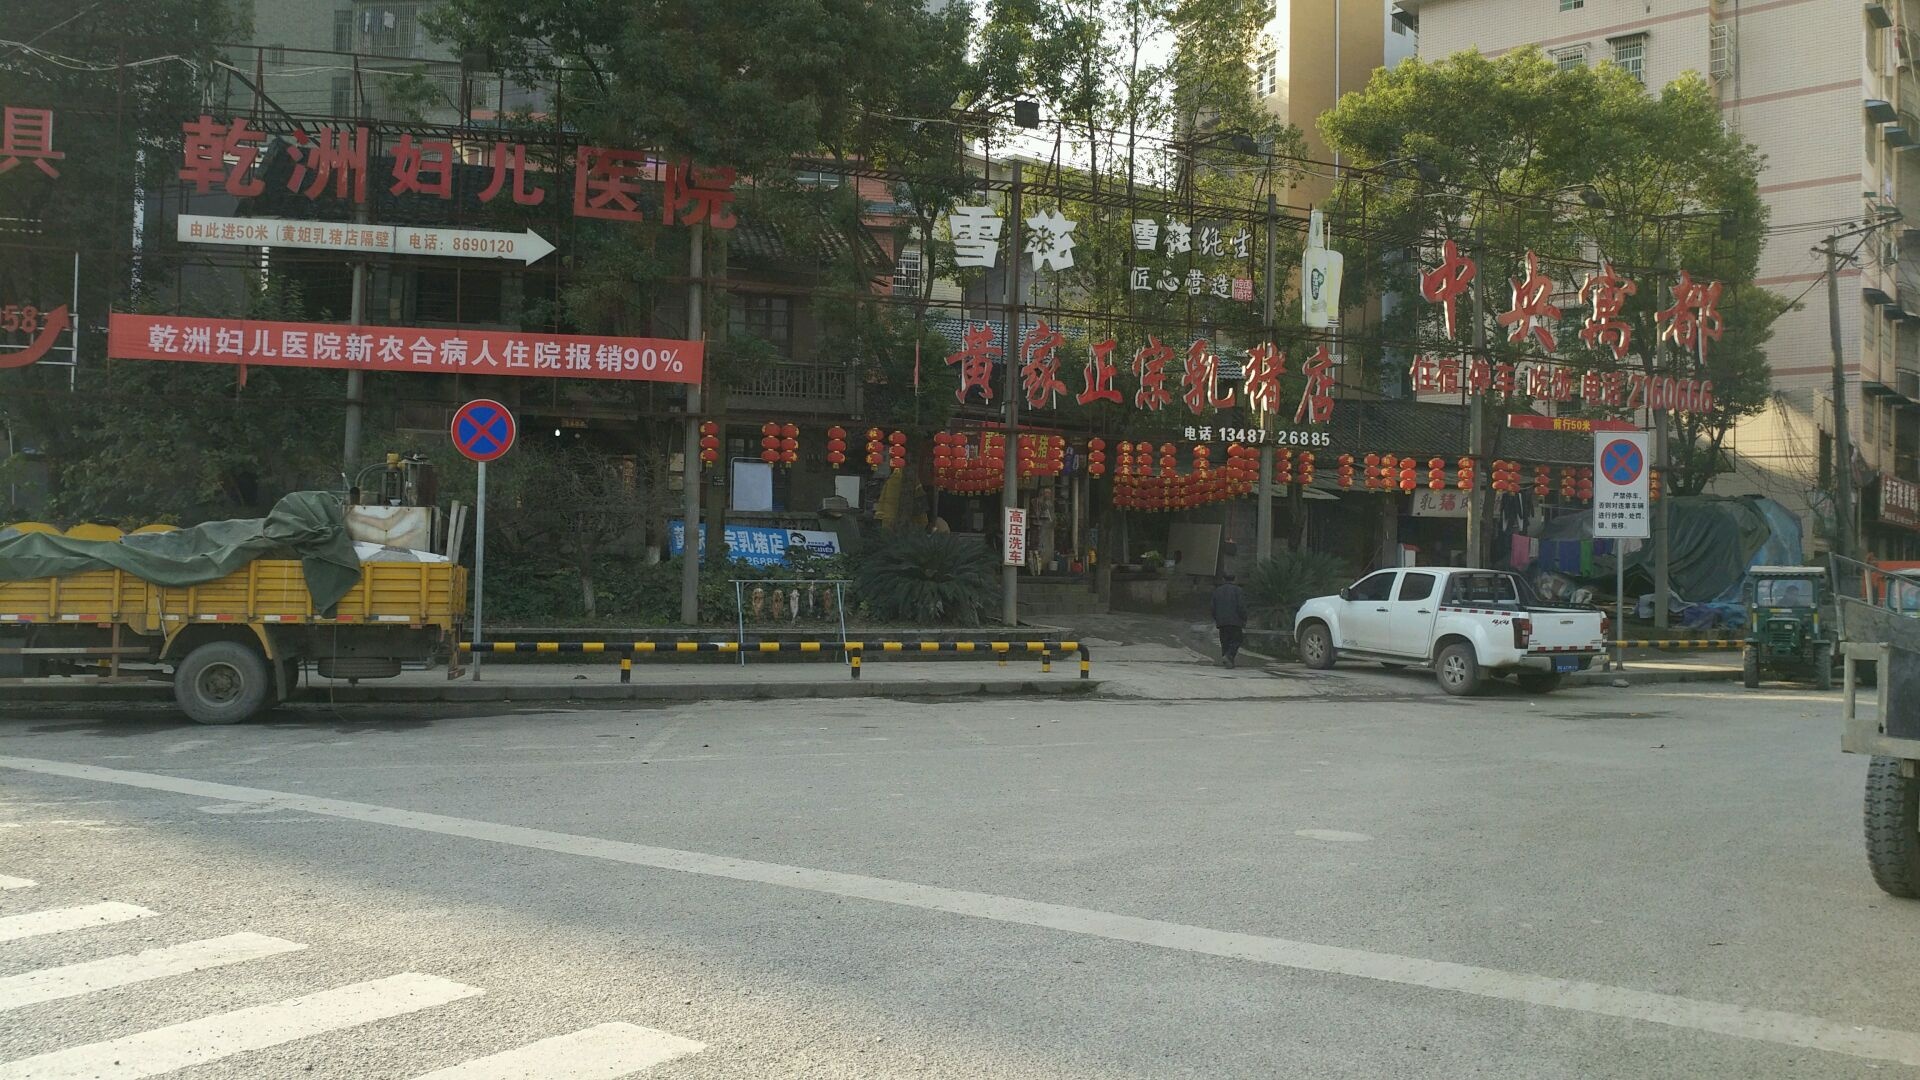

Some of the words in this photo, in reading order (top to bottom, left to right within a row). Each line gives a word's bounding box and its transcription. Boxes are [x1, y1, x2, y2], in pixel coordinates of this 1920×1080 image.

[0, 107, 65, 179] 具
[179, 115, 738, 230] 乾洲妇儿医院
[949, 206, 1078, 271] 雪花
[1132, 218, 1252, 258] 雪花纯生
[1131, 266, 1231, 299] 匠心营造
[148, 324, 684, 374] 乾洲妇儿医院新农合病人住院报销90%
[945, 318, 1336, 424] 黄家正宗乳猪店
[1184, 425, 1212, 441] 电话
[1008, 510, 1024, 563] 高压洗车
